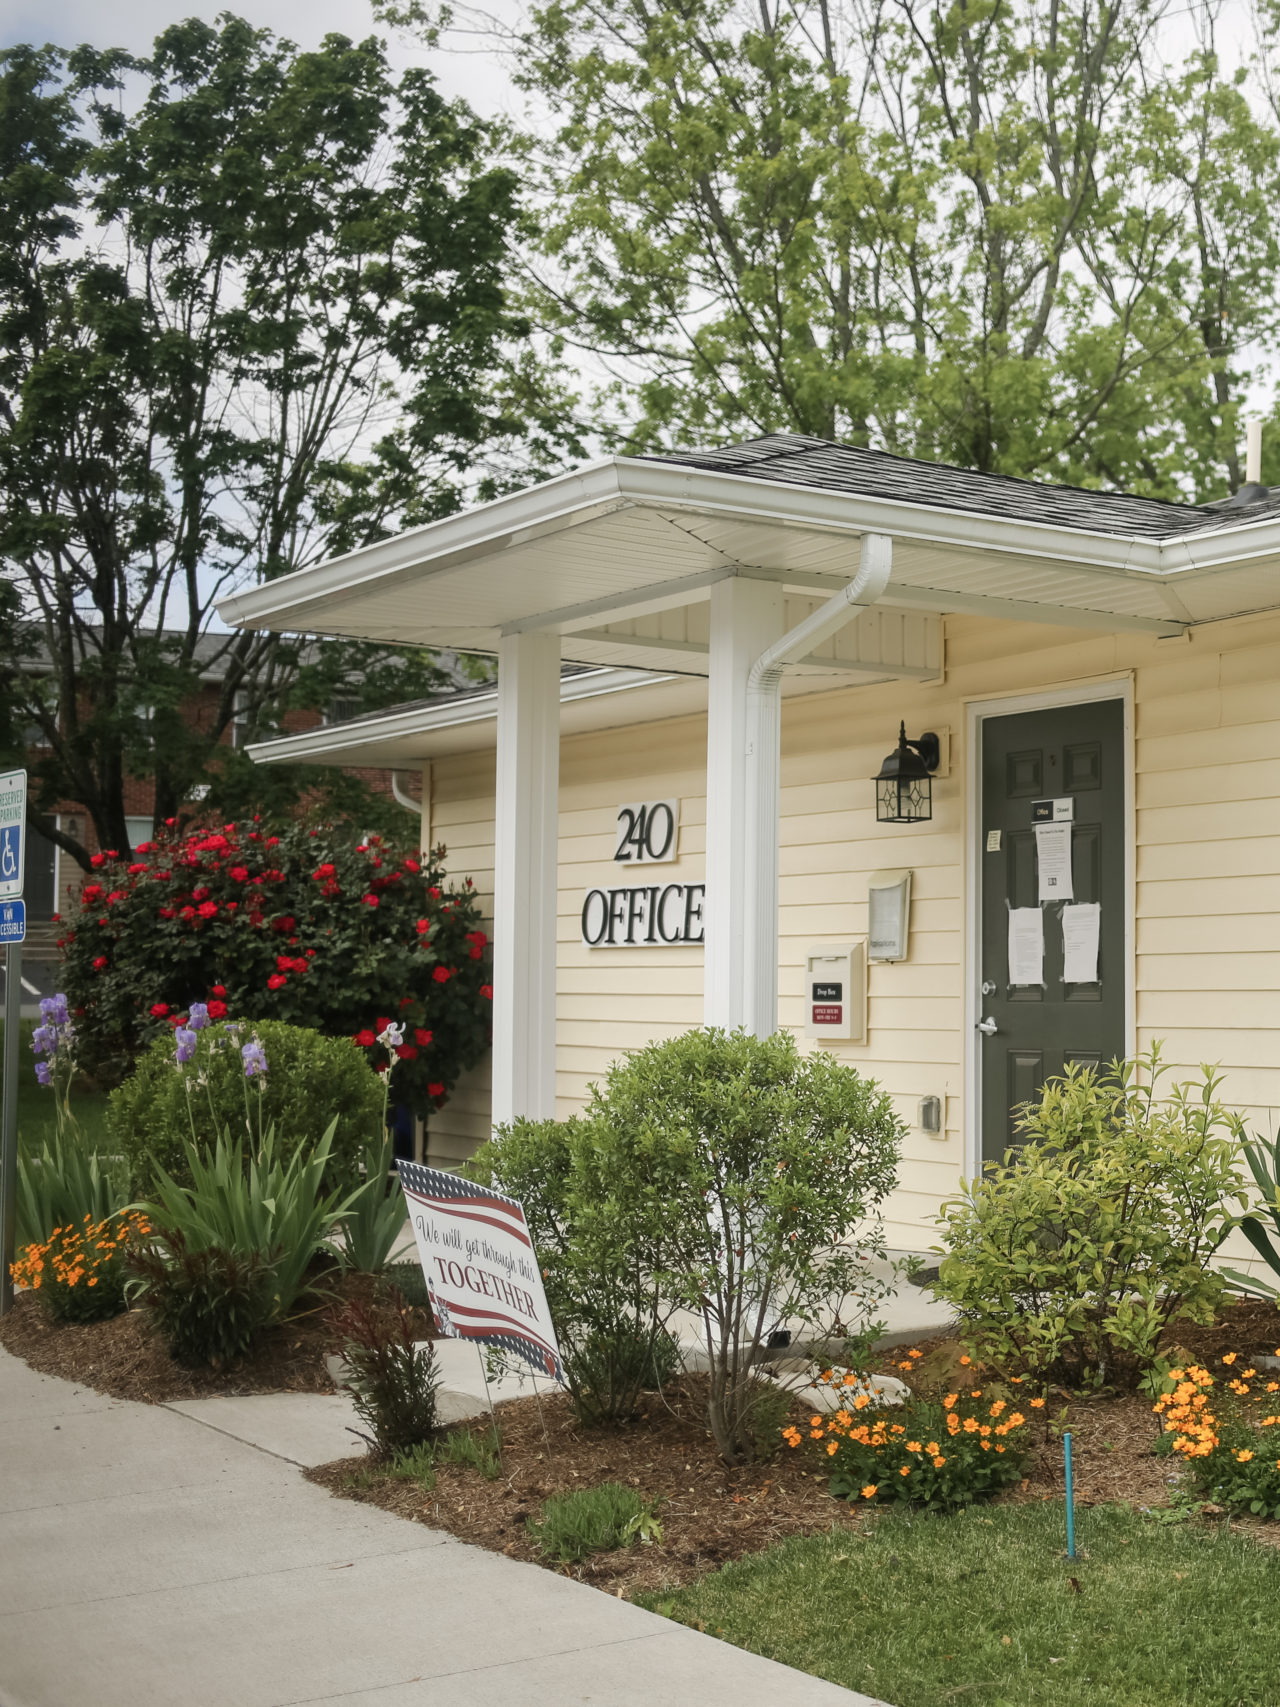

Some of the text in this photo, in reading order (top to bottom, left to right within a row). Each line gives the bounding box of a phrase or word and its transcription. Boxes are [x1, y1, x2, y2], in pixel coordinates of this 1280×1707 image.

[0, 805, 22, 823] PARKING
[613, 802, 675, 862] 240
[0, 921, 24, 936] CESSIBLE
[581, 884, 706, 946] OFFICE
[817, 988, 836, 997] Drop Box
[415, 1214, 536, 1284] We will get through this
[433, 1257, 540, 1322] TOGETHER
